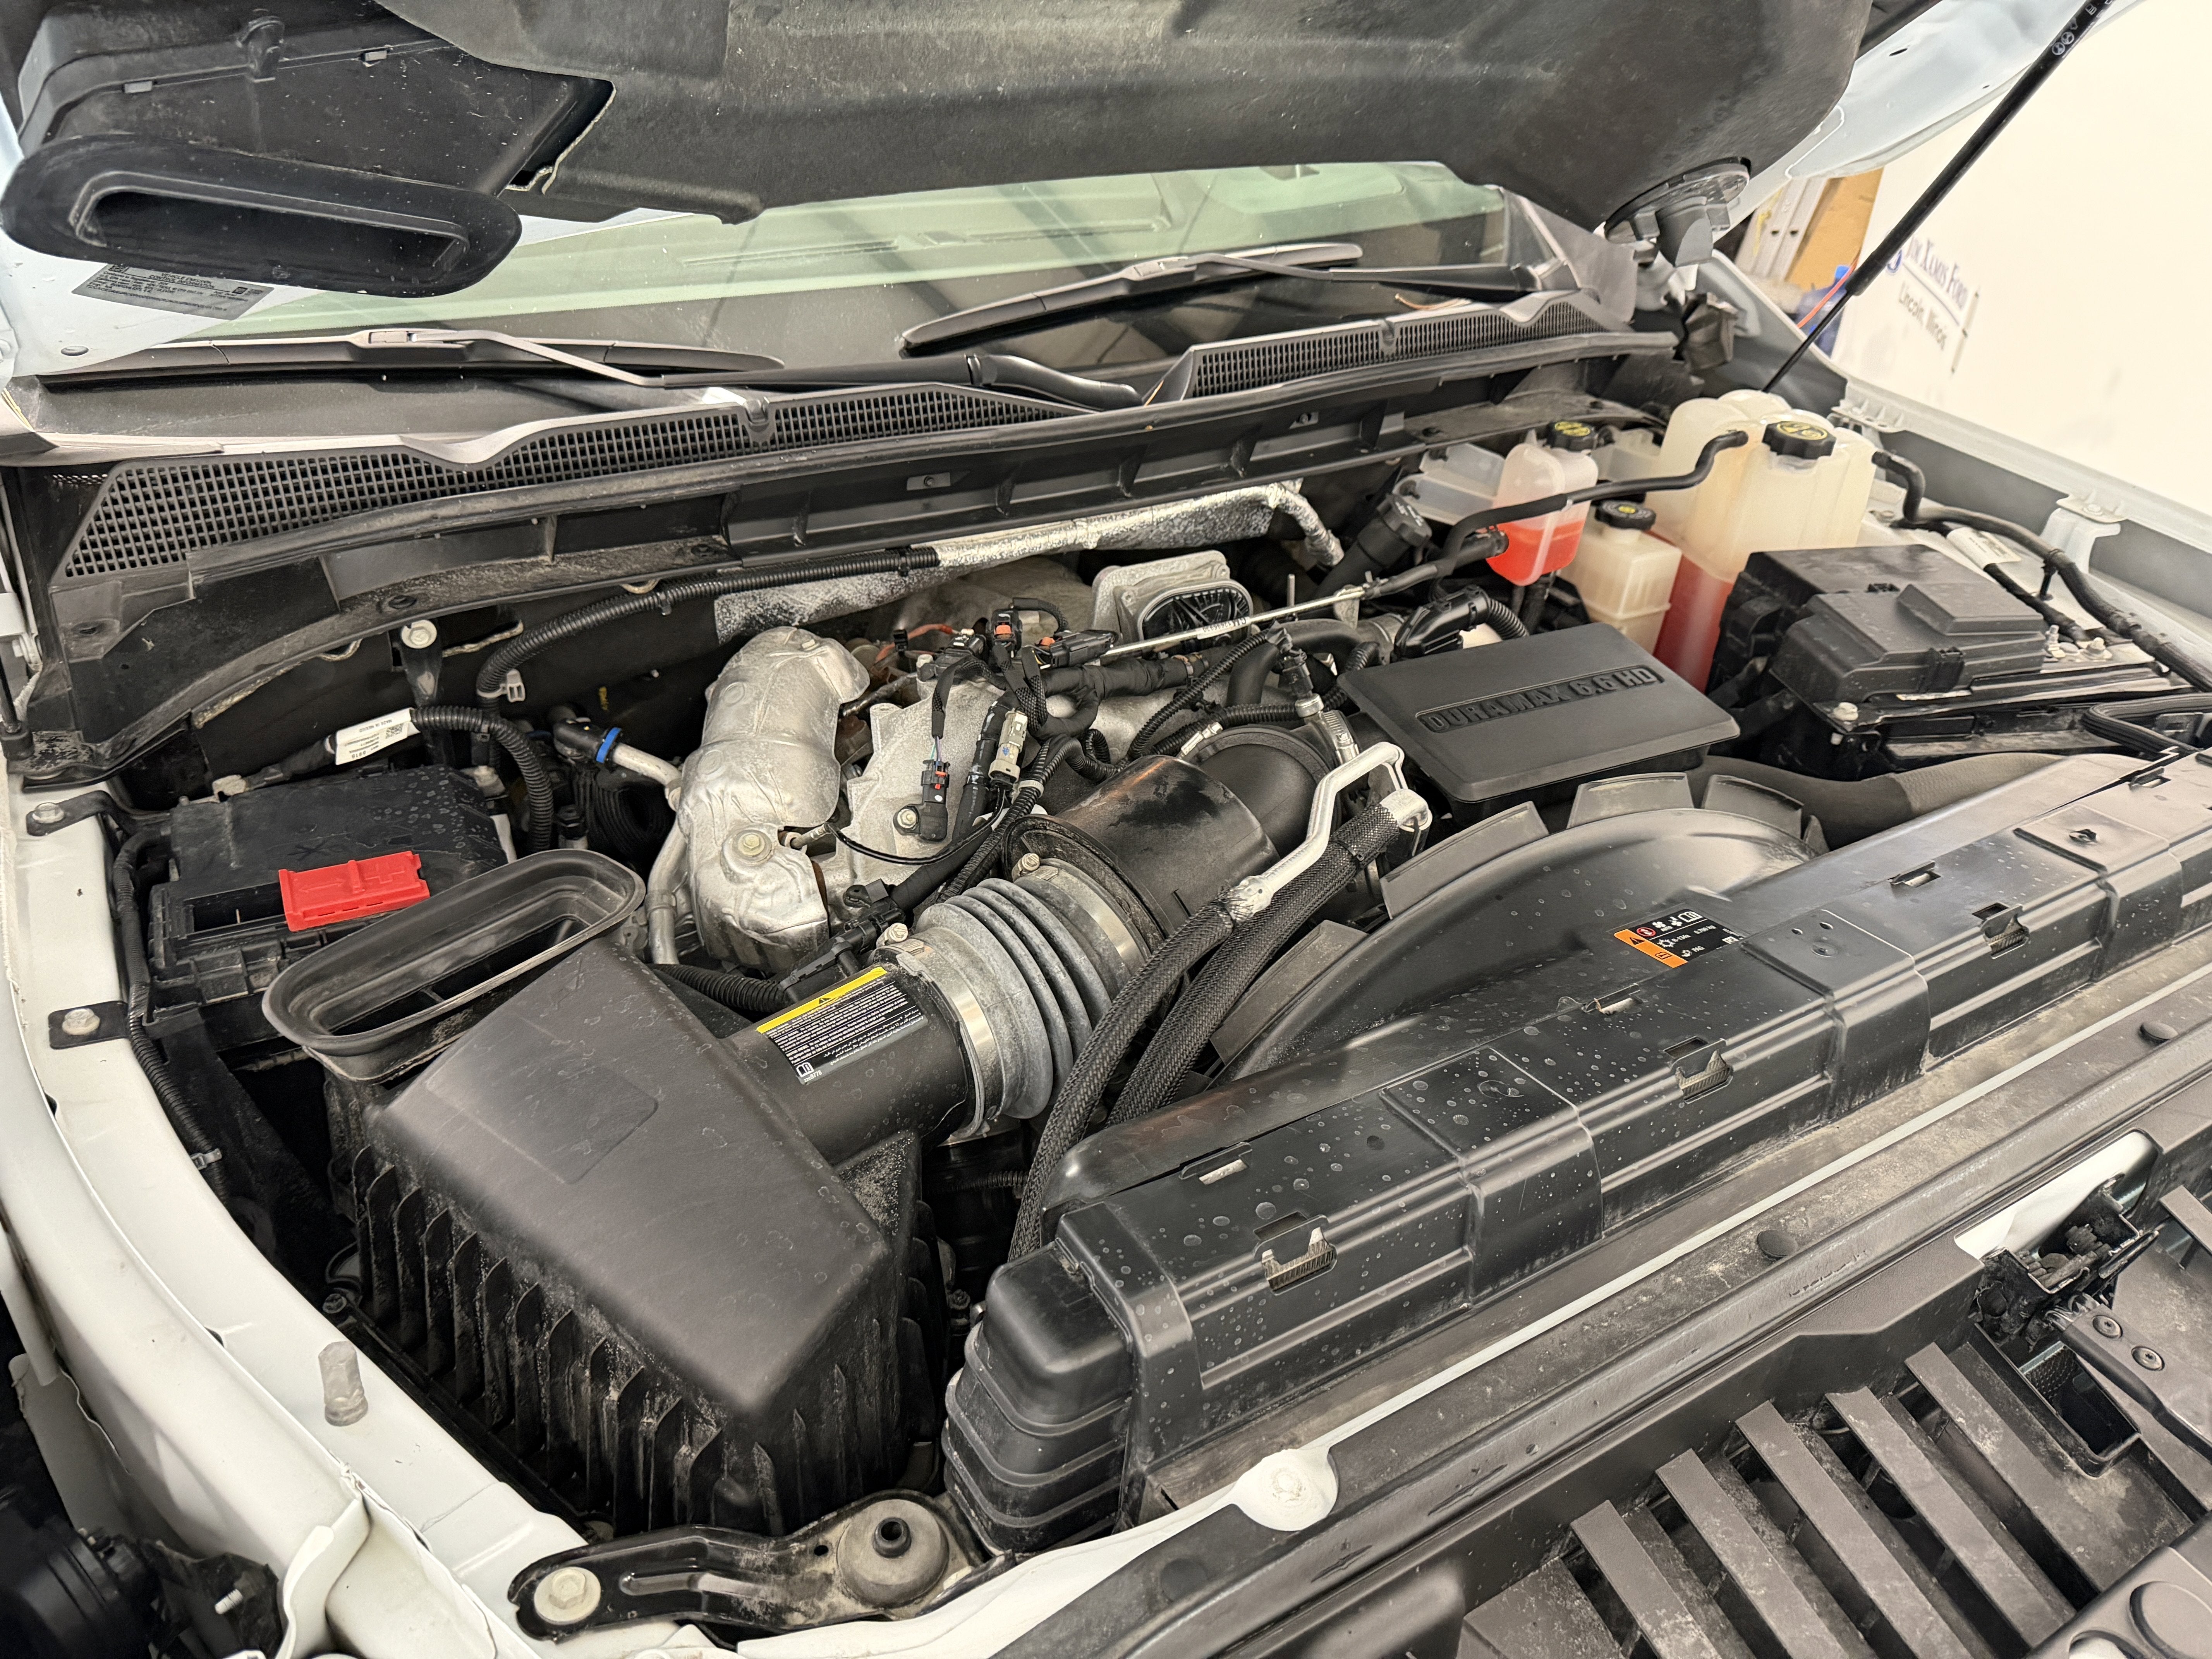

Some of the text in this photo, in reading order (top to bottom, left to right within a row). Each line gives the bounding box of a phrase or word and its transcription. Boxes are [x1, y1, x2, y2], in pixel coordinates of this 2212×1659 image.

[1426, 668, 1658, 731] DURAMAX 6.6 HD
